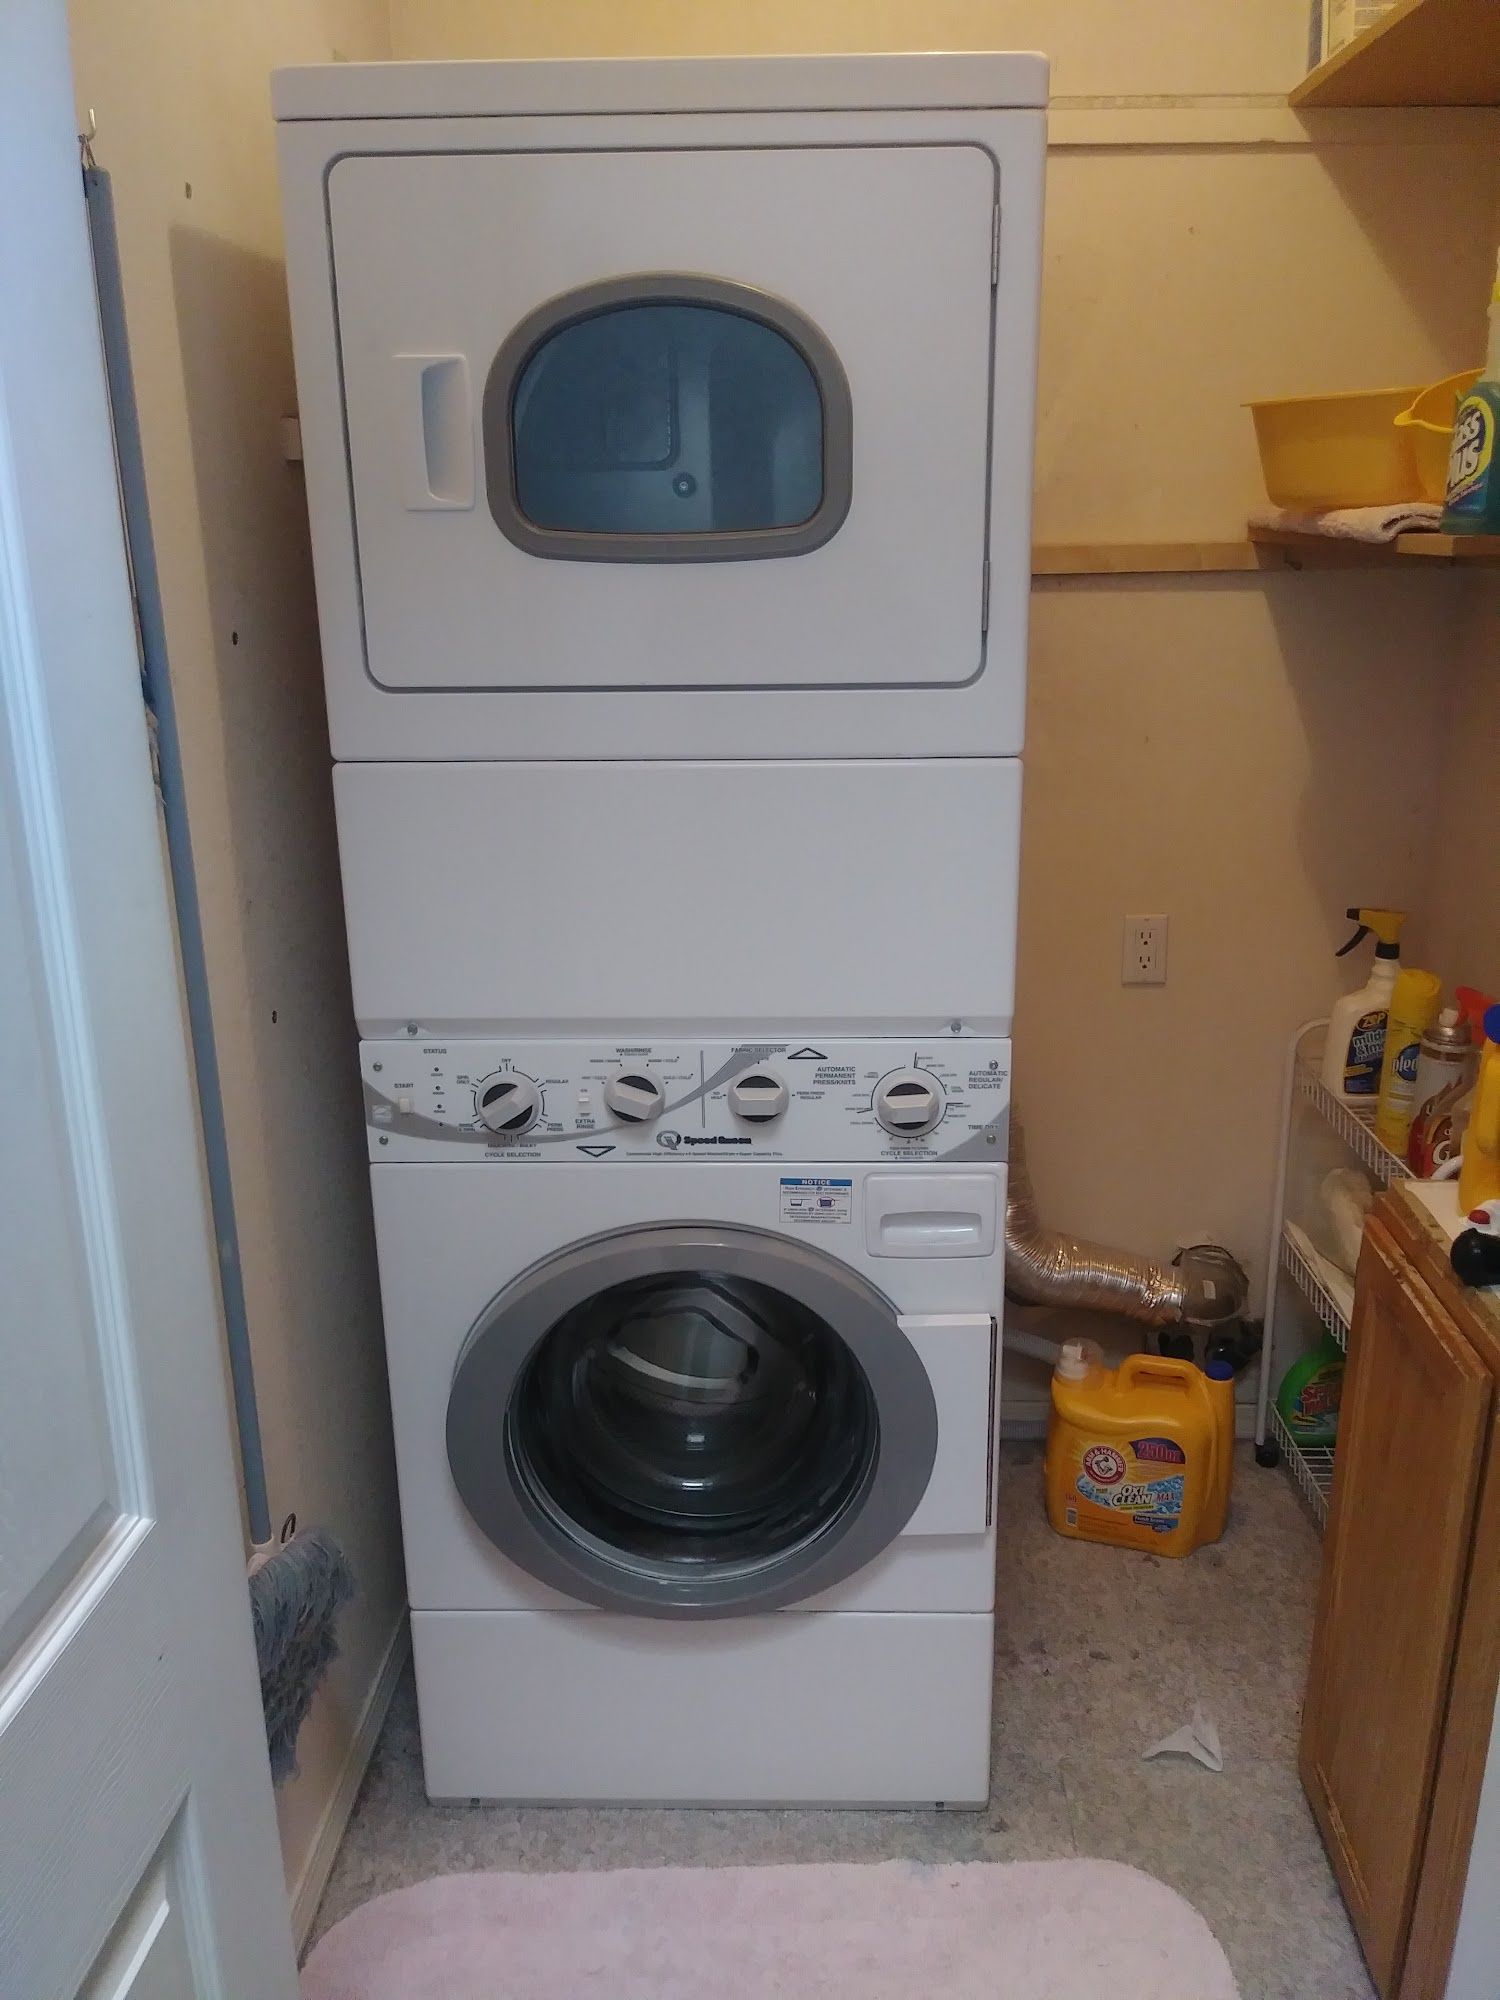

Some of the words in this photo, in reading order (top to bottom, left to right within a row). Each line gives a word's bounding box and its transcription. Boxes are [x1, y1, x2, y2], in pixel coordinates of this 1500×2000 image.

[683, 1135, 717, 1146] Speed
[718, 1135, 752, 1145] Queen
[1121, 1484, 1146, 1496] OXI
[1112, 1492, 1153, 1506] CLEAN
